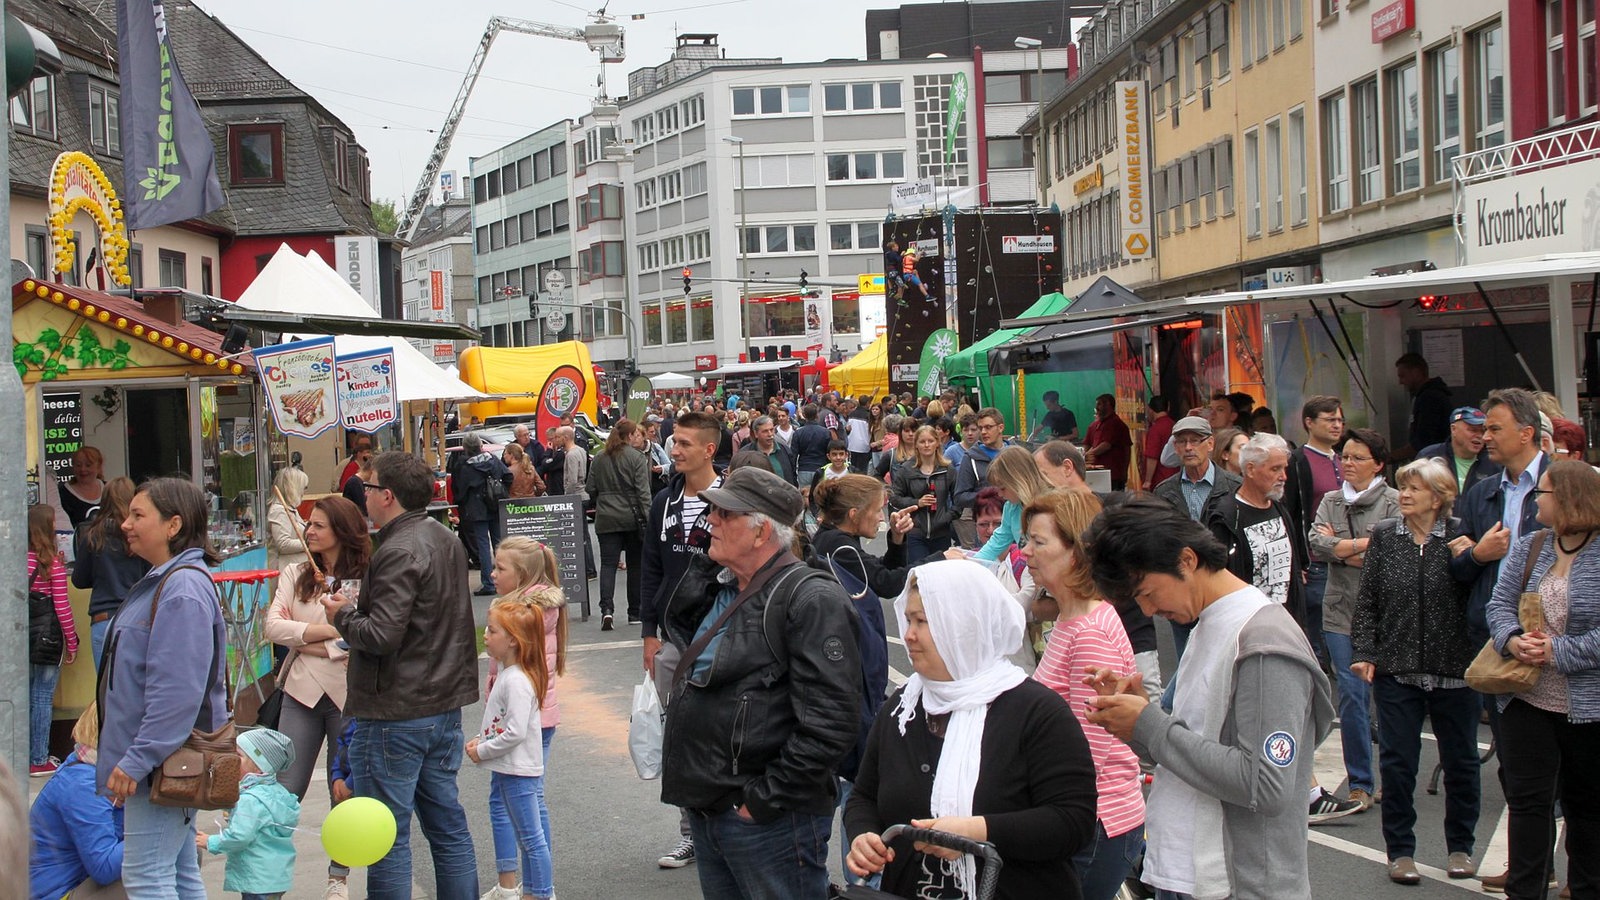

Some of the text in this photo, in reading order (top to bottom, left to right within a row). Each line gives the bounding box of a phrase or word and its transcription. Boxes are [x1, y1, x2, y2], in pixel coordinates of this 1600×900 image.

[1124, 86, 1143, 225] COMMERZBANK
[1477, 186, 1567, 247] Krombacher
[1018, 239, 1053, 249] Hundhausen
[629, 390, 650, 400] Jeep
[346, 409, 392, 424] nutella
[506, 503, 574, 514] VEGGIEWERK
